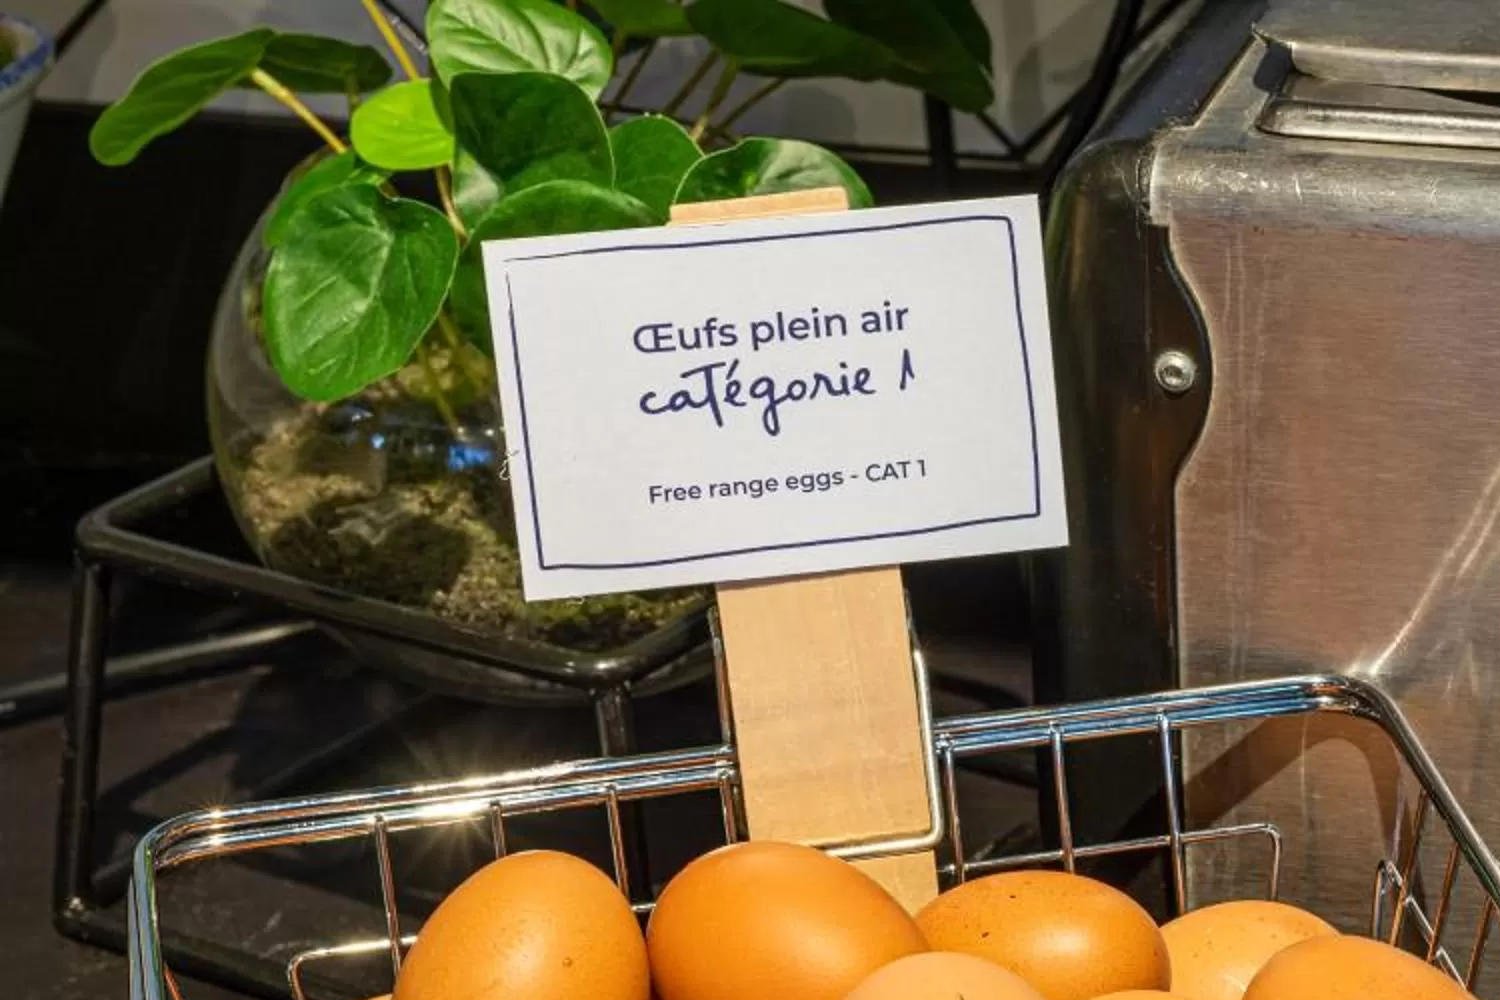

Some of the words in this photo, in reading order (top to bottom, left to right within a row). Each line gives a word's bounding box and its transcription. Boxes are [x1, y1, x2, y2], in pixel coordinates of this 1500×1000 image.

[632, 317, 739, 354] Œufs
[750, 306, 848, 352] plein
[861, 300, 909, 334] air
[639, 357, 877, 437] catégorie
[648, 481, 702, 505] Free
[708, 479, 779, 499] range
[785, 471, 845, 493] eggs
[865, 460, 911, 483] CAT
[916, 459, 926, 477] 1
